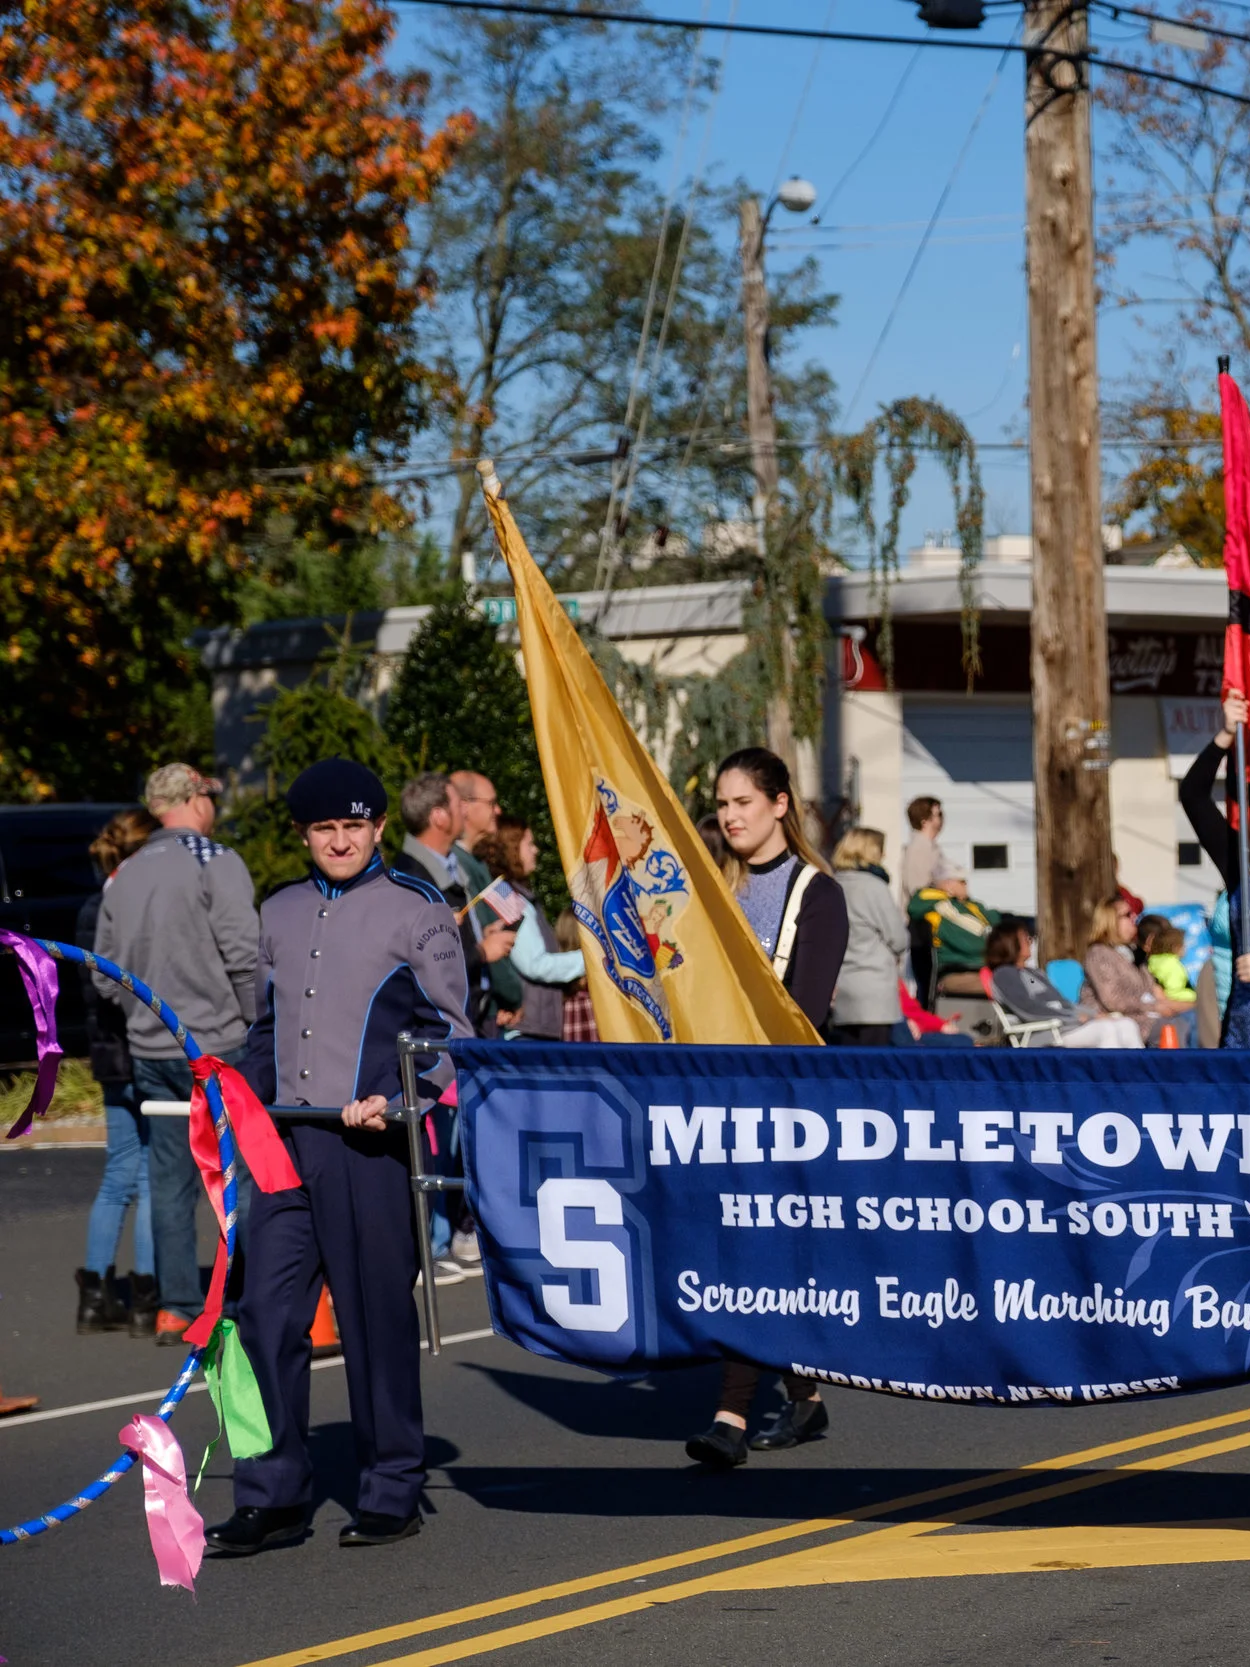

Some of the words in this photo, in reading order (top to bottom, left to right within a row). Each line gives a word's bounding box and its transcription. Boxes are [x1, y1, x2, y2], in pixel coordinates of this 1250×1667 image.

[350, 801, 371, 819] MS
[719, 1193, 845, 1229] HIGH
[855, 1196, 1058, 1234] SCHOOL
[1067, 1201, 1234, 1238] SOUTH
[677, 1270, 860, 1327] Screaming
[875, 1276, 979, 1329] Eagle
[993, 1278, 1170, 1337] Marching
[1007, 1384, 1074, 1402] NEW
[1080, 1375, 1182, 1402] JERSEY
